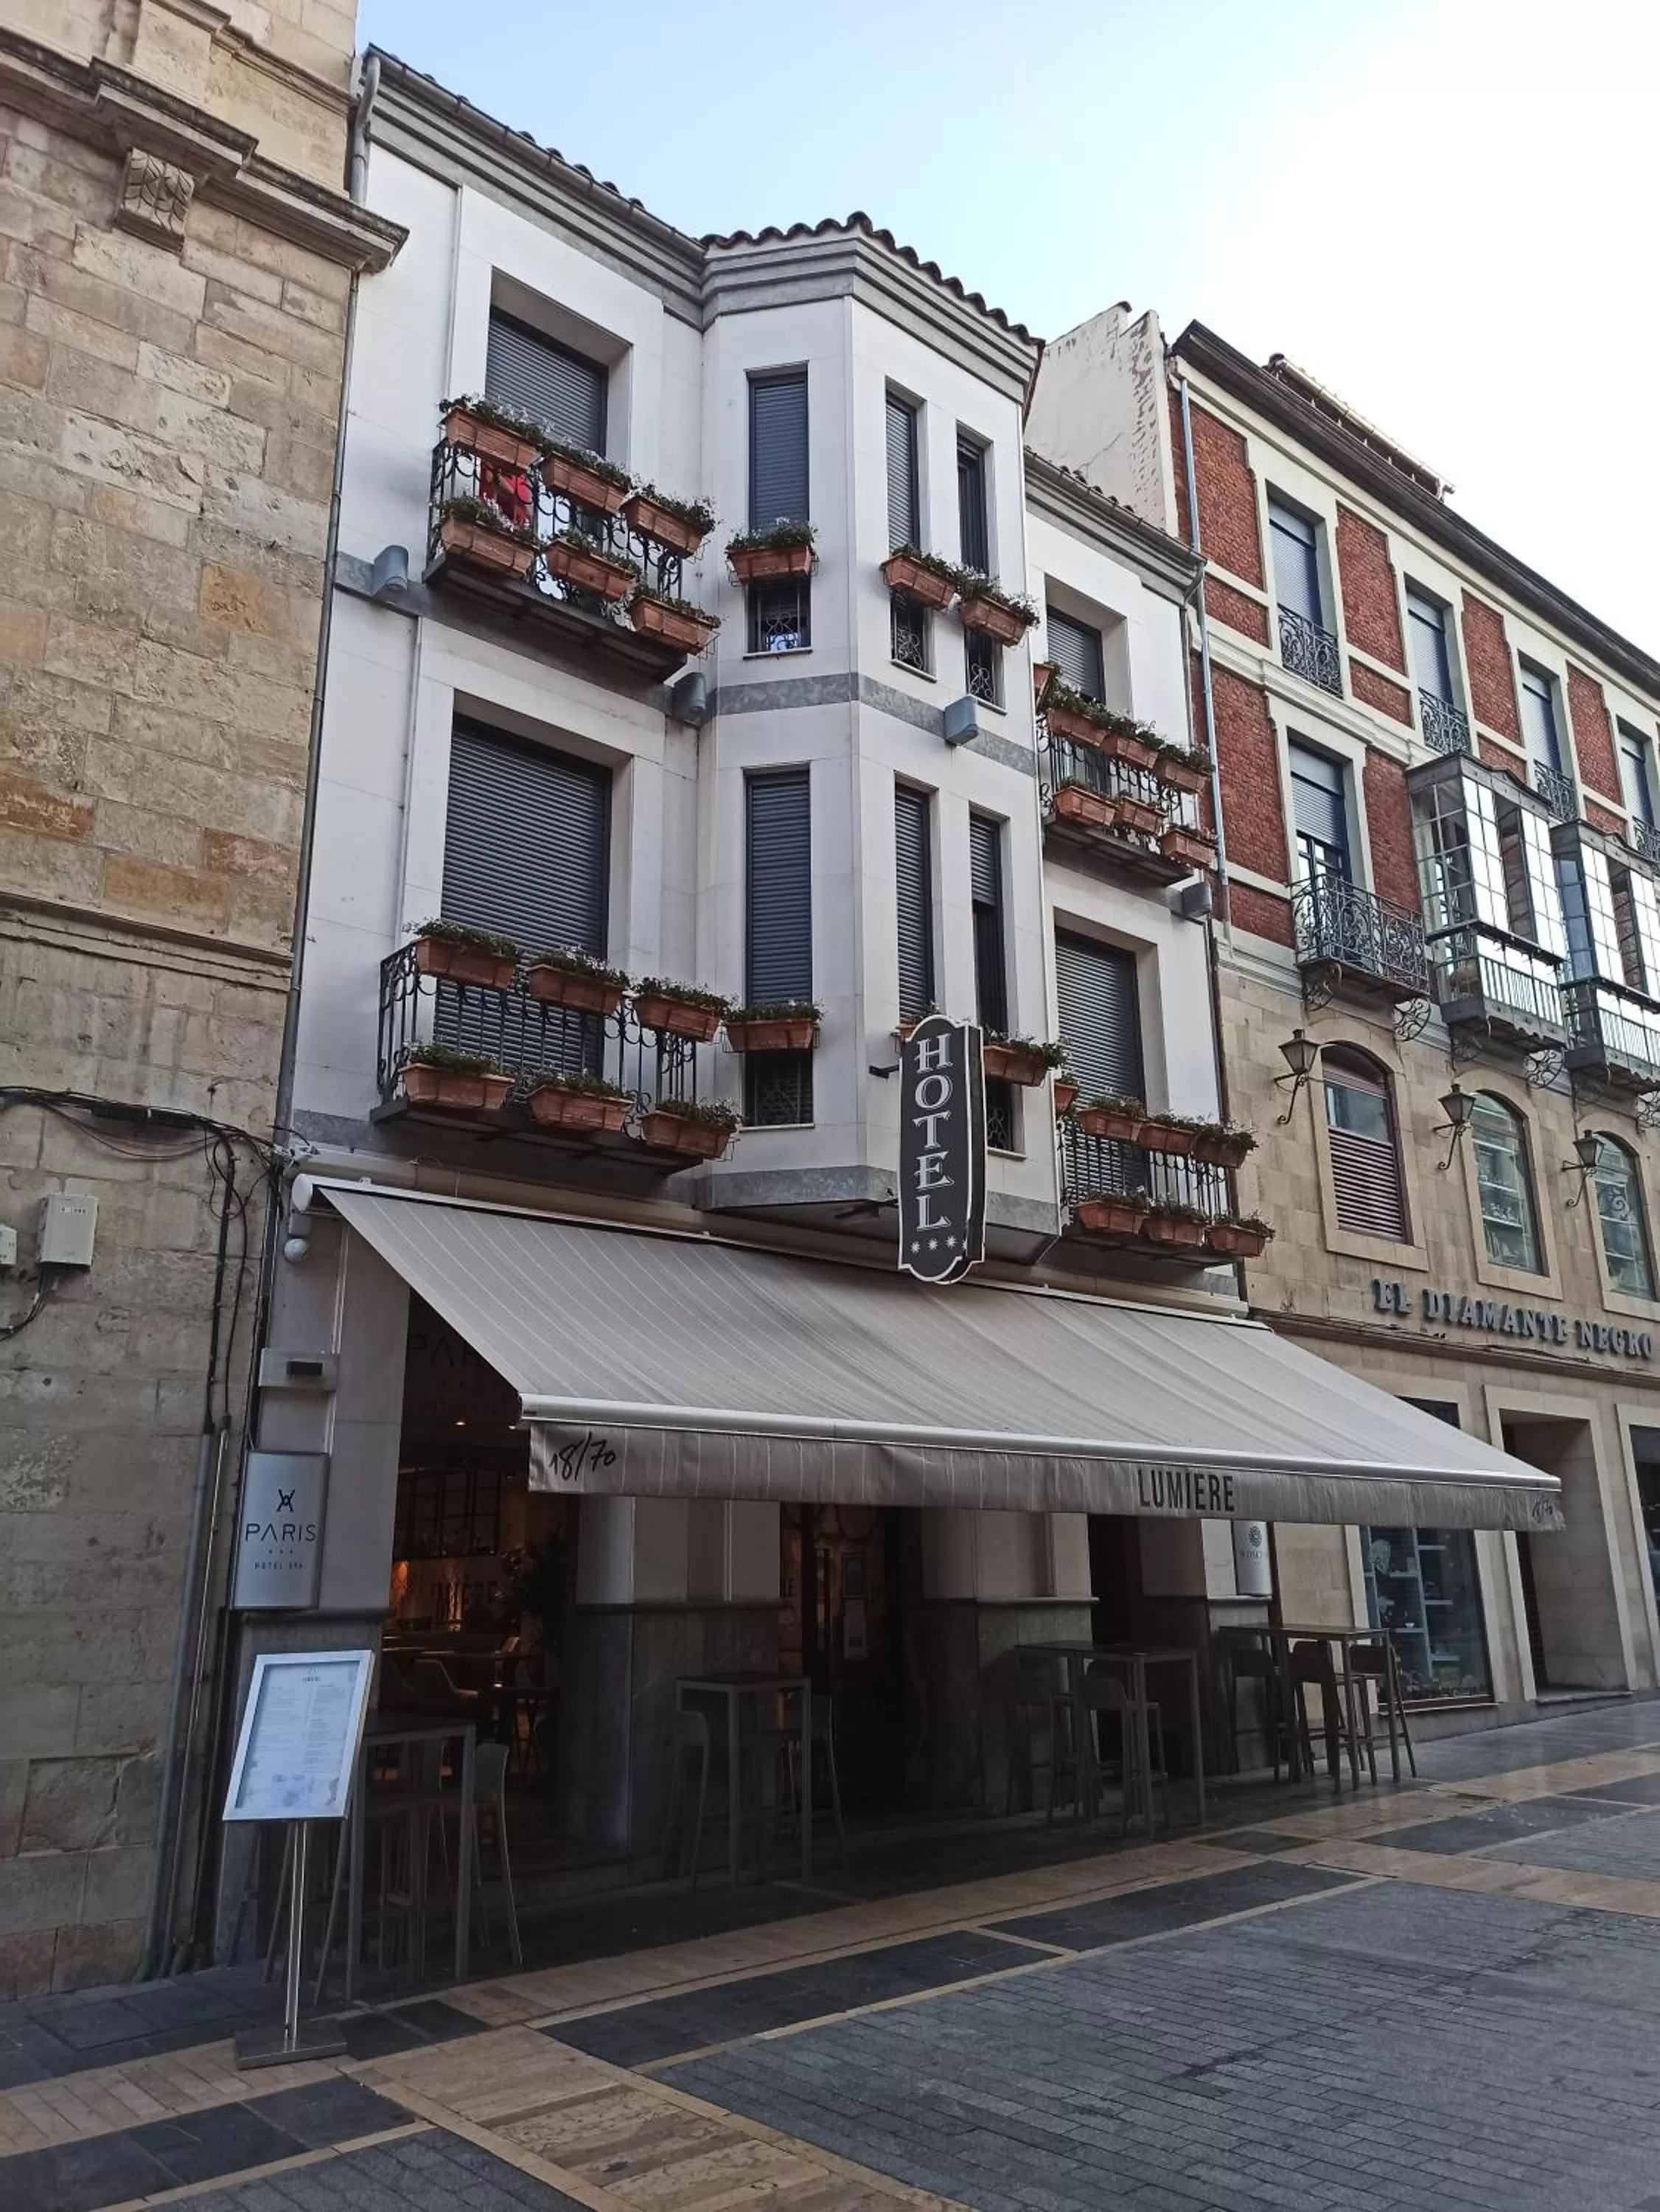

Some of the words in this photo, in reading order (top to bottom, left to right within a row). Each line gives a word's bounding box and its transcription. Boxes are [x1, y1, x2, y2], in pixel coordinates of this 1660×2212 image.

[913, 1033, 954, 1233] HOTEL
[1373, 1278, 1412, 1316] EL
[1422, 1287, 1569, 1344] DIAMANTE
[1575, 1319, 1653, 1360] NEGRO
[1137, 1469, 1235, 1512] LUMIERE
[245, 1523, 318, 1543] PARIS
[254, 1561, 283, 1570] HOTEL
